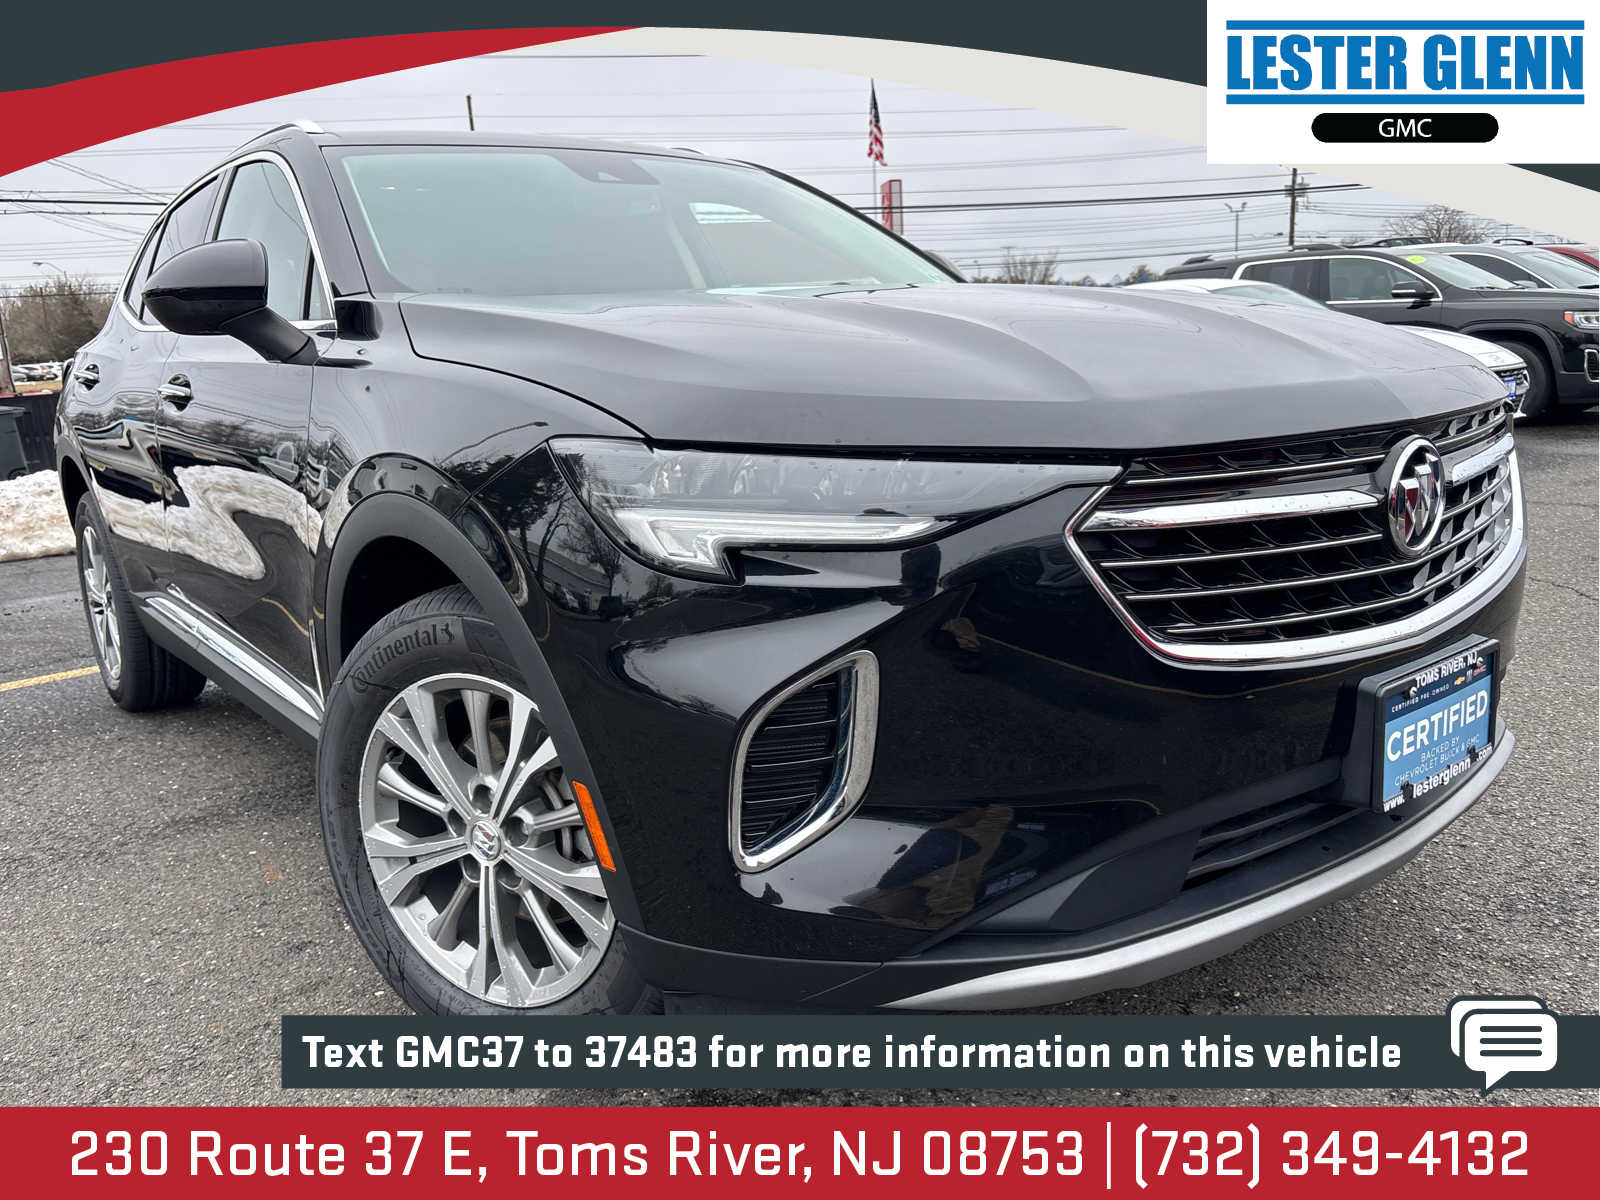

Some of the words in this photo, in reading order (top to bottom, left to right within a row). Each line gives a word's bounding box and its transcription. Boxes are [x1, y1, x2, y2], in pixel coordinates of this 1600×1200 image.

[351, 622, 439, 694] Continental
[1415, 668, 1441, 690] TOMS
[1391, 695, 1420, 713] CERTIFIED
[1386, 689, 1489, 763] CERTIFIED
[1420, 741, 1450, 763] BACKED
[1450, 734, 1461, 748] BY
[1394, 758, 1440, 787] CHEVROLET
